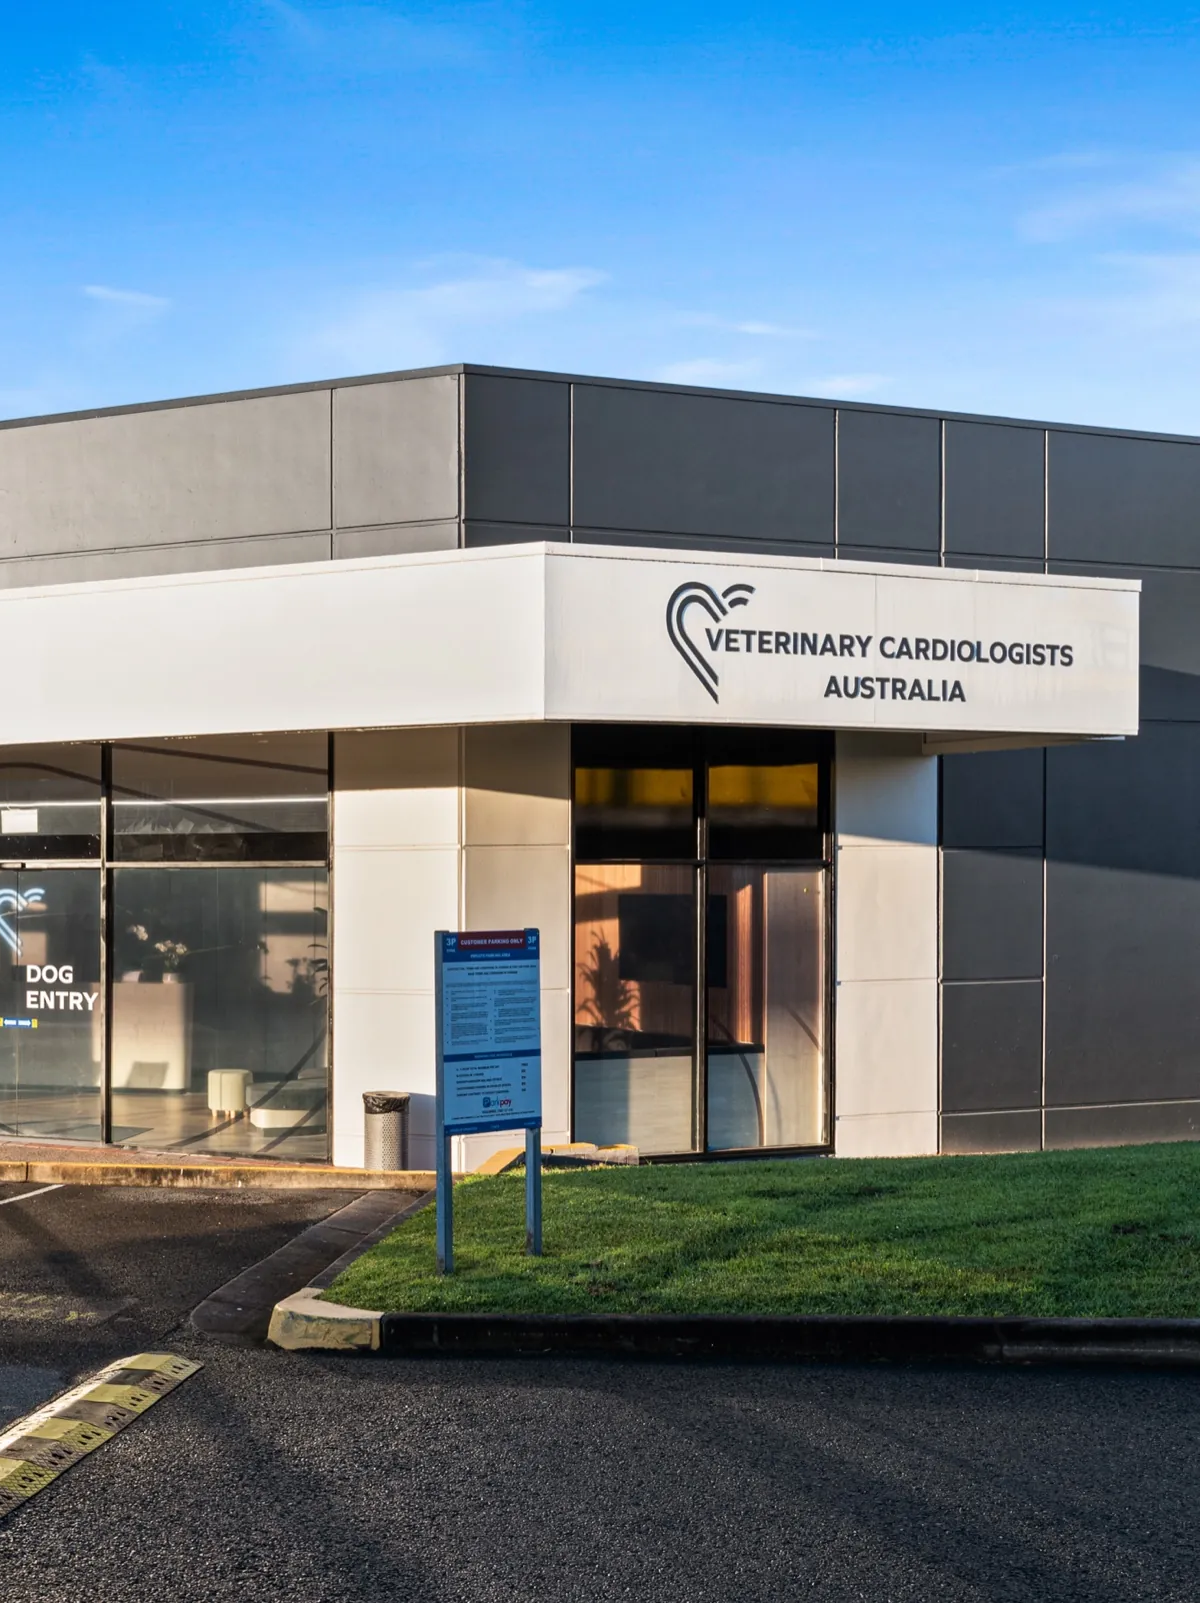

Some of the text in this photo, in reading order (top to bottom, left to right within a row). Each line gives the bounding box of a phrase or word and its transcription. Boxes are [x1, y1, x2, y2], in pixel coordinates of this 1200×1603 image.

[705, 627, 1074, 667] VETERINARY CARDIOLOGISTS
[823, 675, 967, 703] AUSTRALIA
[460, 938, 488, 946] CUSTOMER
[26, 964, 74, 984] DOG
[26, 990, 99, 1011] ENTRY
